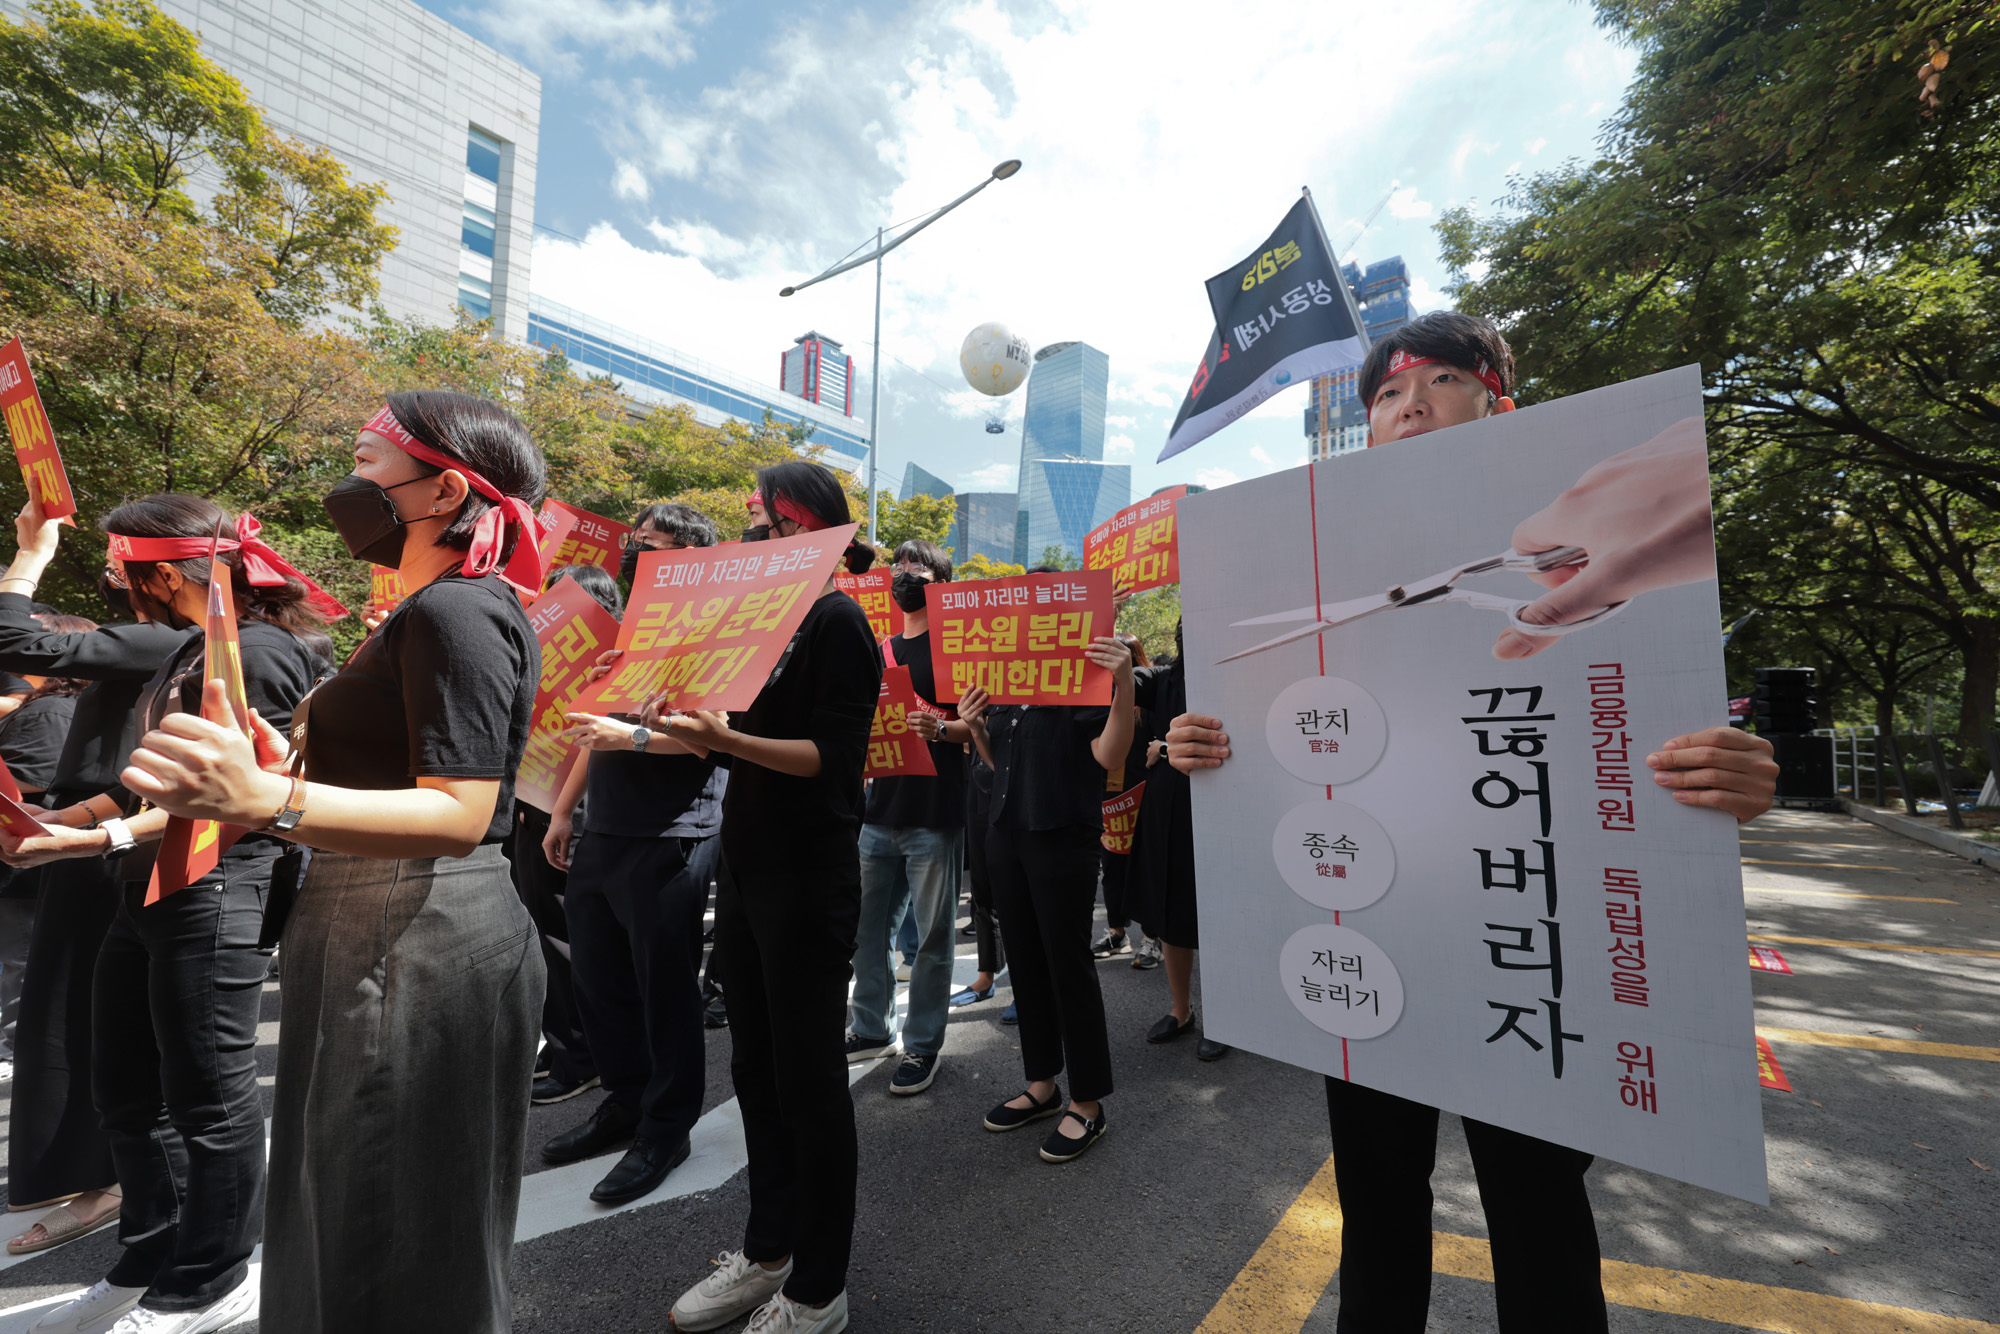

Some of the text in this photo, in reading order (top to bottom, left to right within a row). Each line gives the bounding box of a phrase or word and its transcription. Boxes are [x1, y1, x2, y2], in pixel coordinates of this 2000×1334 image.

[3, 394, 47, 451] 비자
[1111, 511, 1137, 533] 자리만
[1140, 499, 1171, 520] 늘리는
[1132, 514, 1174, 554] 분리
[653, 546, 822, 588] 모피아 자리만 늘리는
[1112, 550, 1169, 589] 한다!
[628, 580, 810, 651] 금소원 분리
[858, 591, 891, 615] 분리
[942, 583, 1087, 610] 모피아 자리만 늘리는
[942, 611, 1094, 654] 금소원 분리
[596, 646, 760, 703] 반대한다!
[952, 658, 1085, 696] 반대한다!
[1295, 708, 1349, 735] 관치
[1308, 739, 1339, 754] 官治
[1302, 832, 1360, 862] 종속
[1461, 685, 1584, 1079] 끊어버리자
[1587, 662, 1657, 1114] 금융감독원 독립성을 위해
[1312, 949, 1362, 981] 자리
[1300, 975, 1379, 1017] 늘리기
